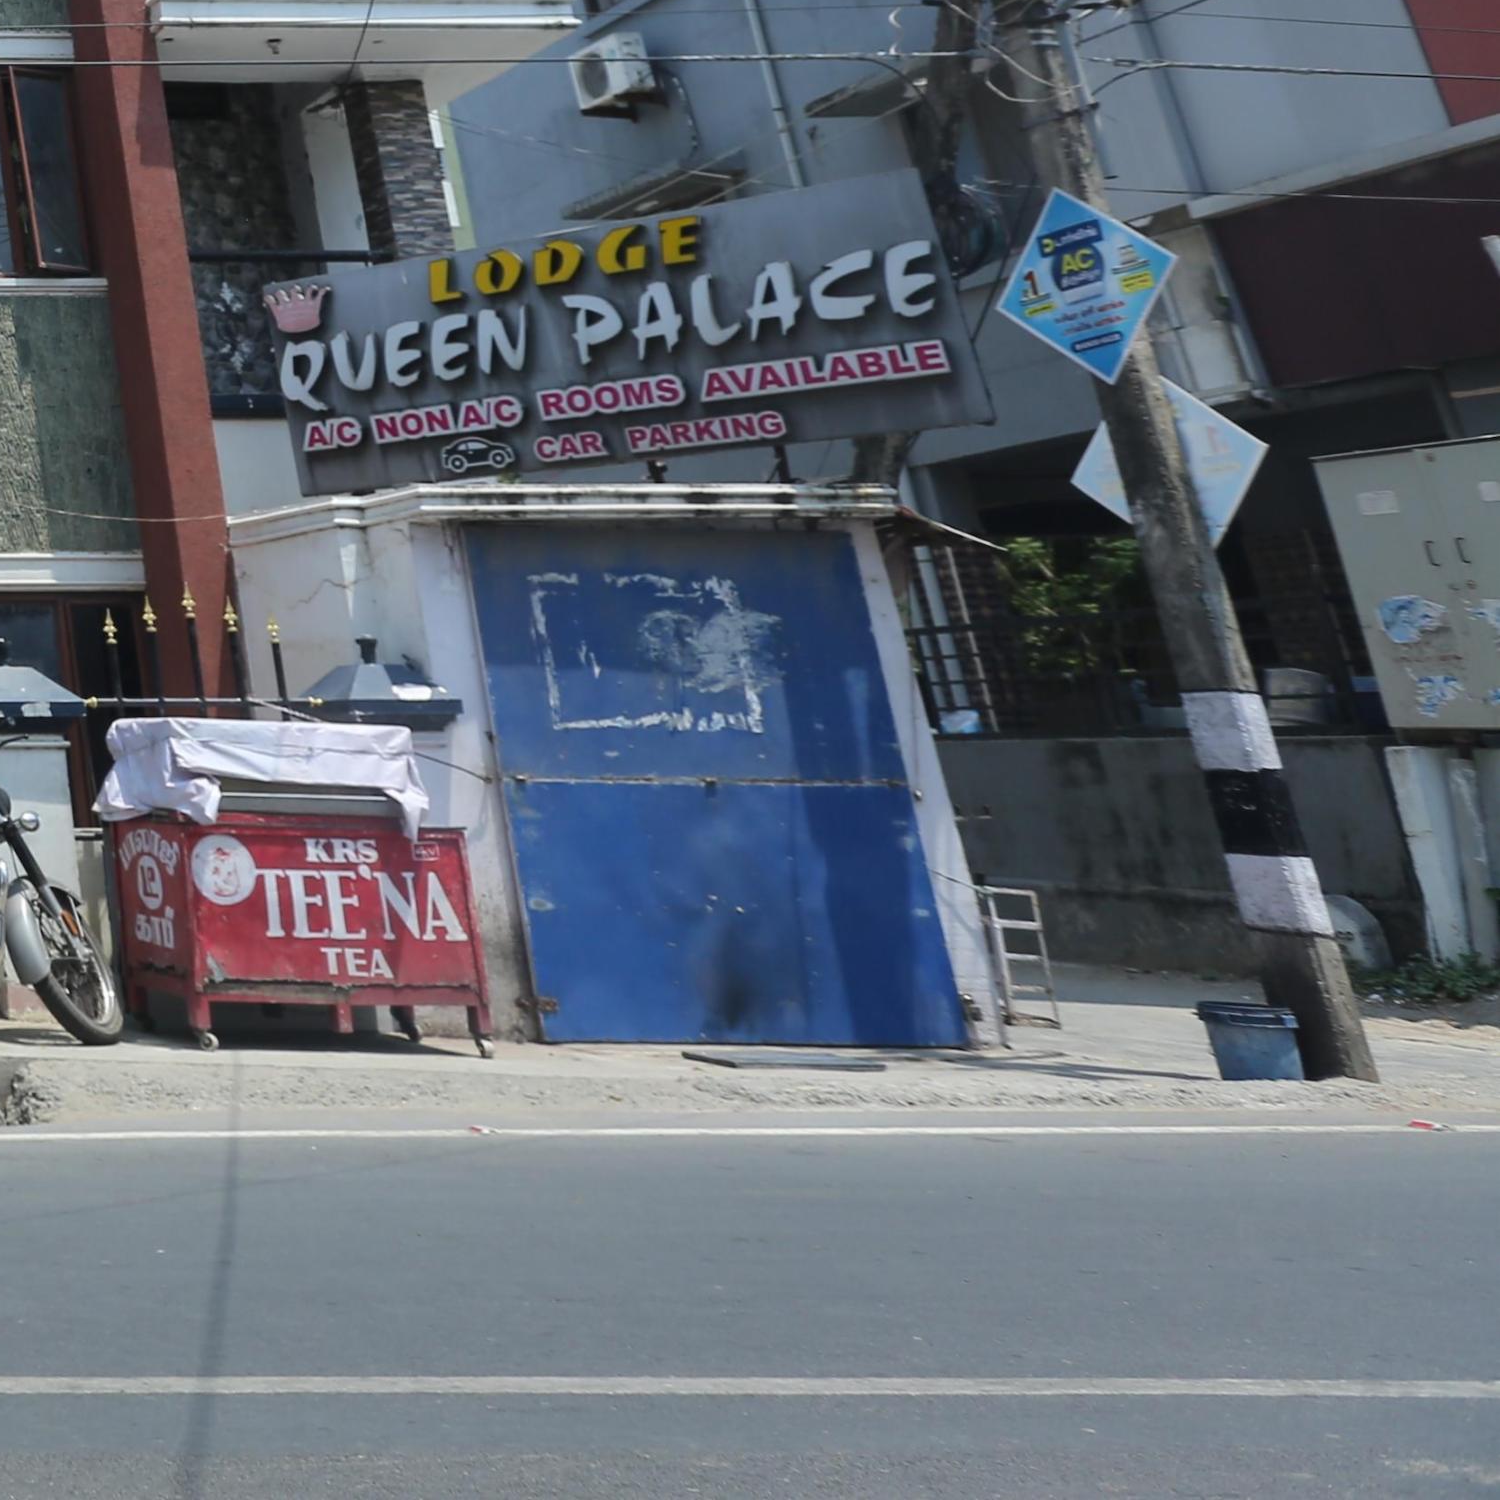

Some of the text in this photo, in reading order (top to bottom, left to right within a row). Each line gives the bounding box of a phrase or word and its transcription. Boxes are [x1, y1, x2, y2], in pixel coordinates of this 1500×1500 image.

[428, 215, 698, 304] LODGE
[1061, 248, 1095, 276] AC
[279, 239, 936, 412] QUEEN PALACE
[306, 342, 948, 449] A/C NON A/C ROOMS AVAILABLE
[536, 413, 785, 460] CAR PARKING
[303, 837, 380, 865] KRS
[320, 946, 395, 980] TEA
